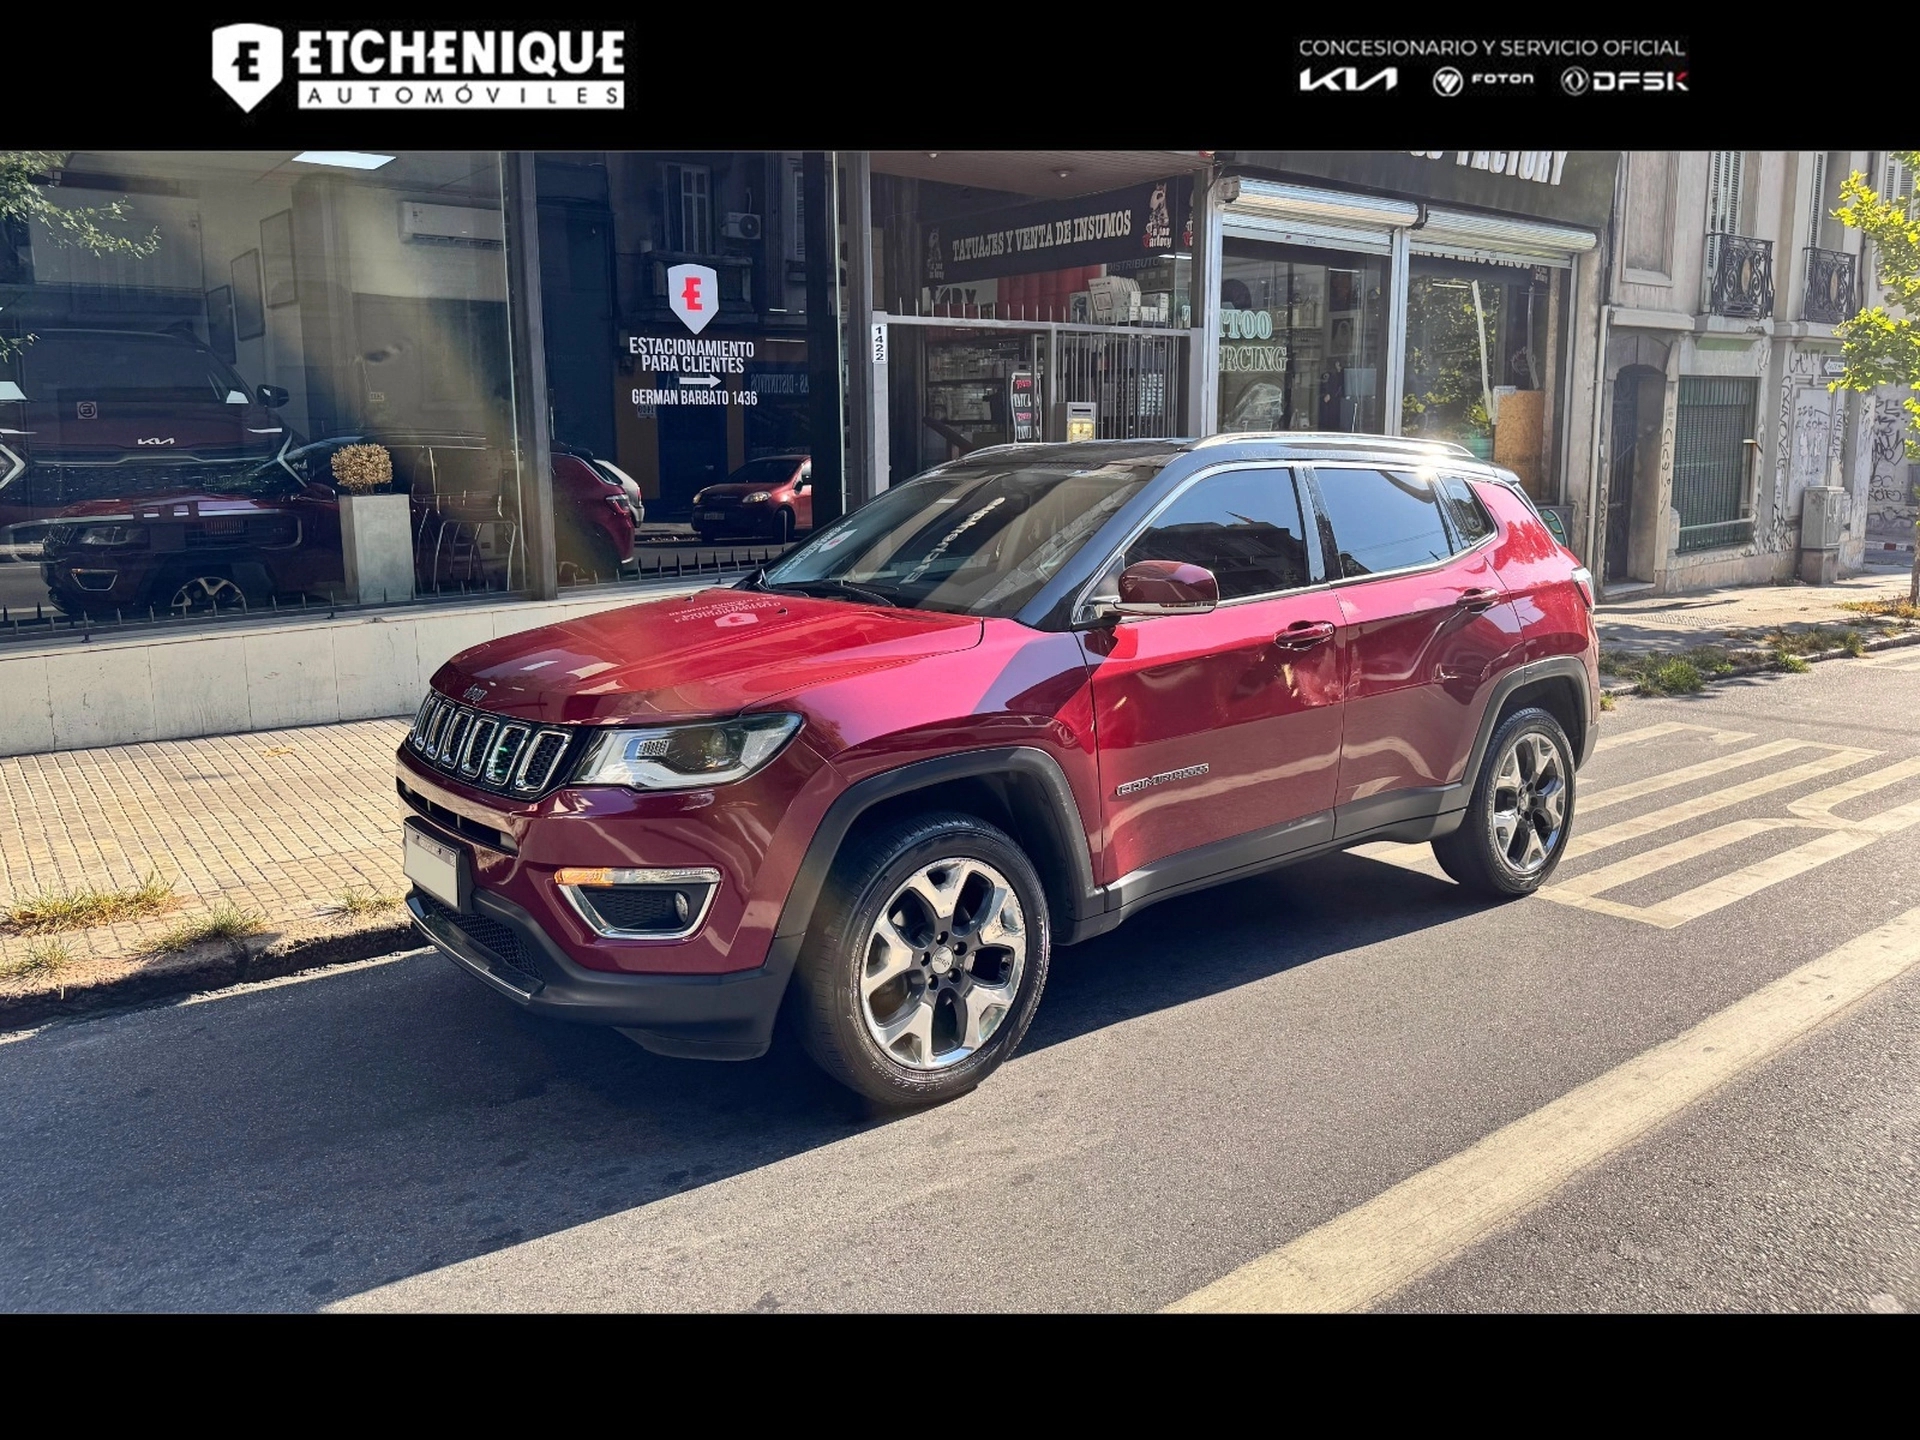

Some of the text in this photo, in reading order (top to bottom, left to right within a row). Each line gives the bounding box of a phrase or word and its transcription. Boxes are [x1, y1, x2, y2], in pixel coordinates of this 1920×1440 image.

[952, 209, 1132, 263] TATUAJES Y VENTA DE INSUMOS
[629, 336, 755, 358] ESTACIONAMIENTO
[874, 326, 884, 361] 1422
[642, 355, 745, 374] PARA CLIENTES
[632, 388, 758, 406] GERMAN BARBATO 1436
[137, 437, 175, 445] KIA
